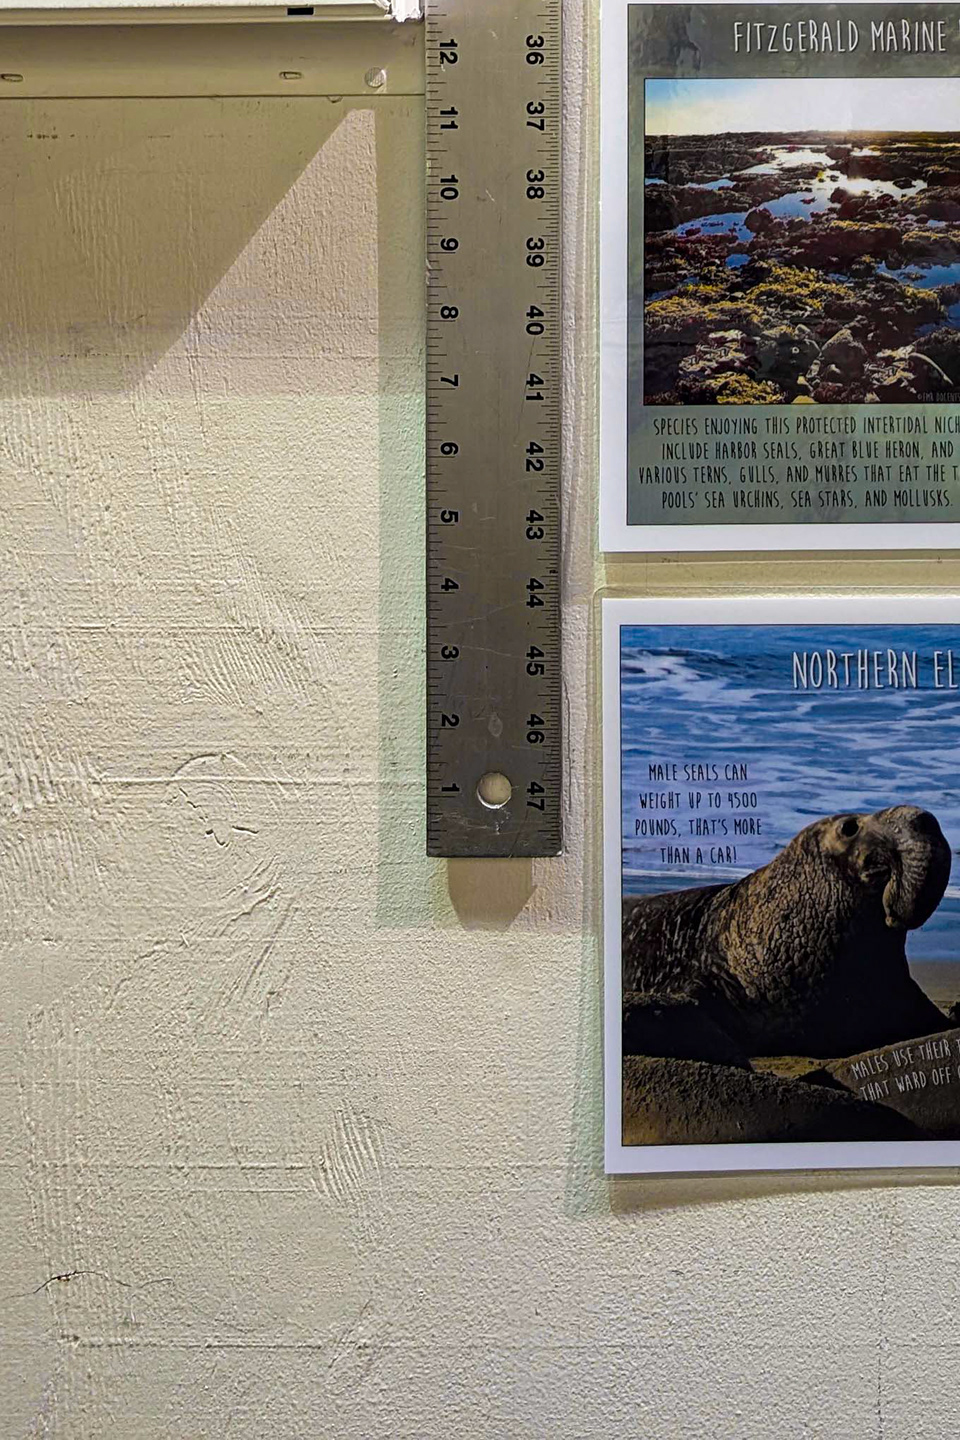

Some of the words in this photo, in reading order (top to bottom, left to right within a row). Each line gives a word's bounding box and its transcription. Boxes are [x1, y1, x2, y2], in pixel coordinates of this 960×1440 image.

[733, 21, 859, 53] FITZGERALD
[871, 21, 947, 53] MARINE
[439, 107, 458, 132] 11
[526, 170, 544, 201] 38
[441, 305, 459, 320] 8
[527, 442, 544, 472] 42
[792, 648, 918, 689] NORTHERN
[648, 764, 678, 781] MALE
[683, 764, 719, 781] SEALS
[724, 764, 748, 781] CAN
[527, 782, 544, 811] 47
[639, 791, 681, 809] WEIGHT
[688, 792, 702, 809] UP
[708, 792, 721, 809] TO
[727, 792, 758, 809] 4500
[635, 819, 682, 838] POUNDS,
[688, 818, 728, 836] THAT'S
[734, 817, 762, 836] MORE
[660, 846, 690, 864] THAN
[696, 847, 703, 864] A
[710, 846, 737, 864] CAR!
[851, 1054, 889, 1081] MALES
[892, 1046, 914, 1067] USE
[918, 1038, 951, 1060] THEIR
[860, 1080, 890, 1102] THAT
[895, 1070, 926, 1093] WARD
[932, 1066, 951, 1086] OFF
